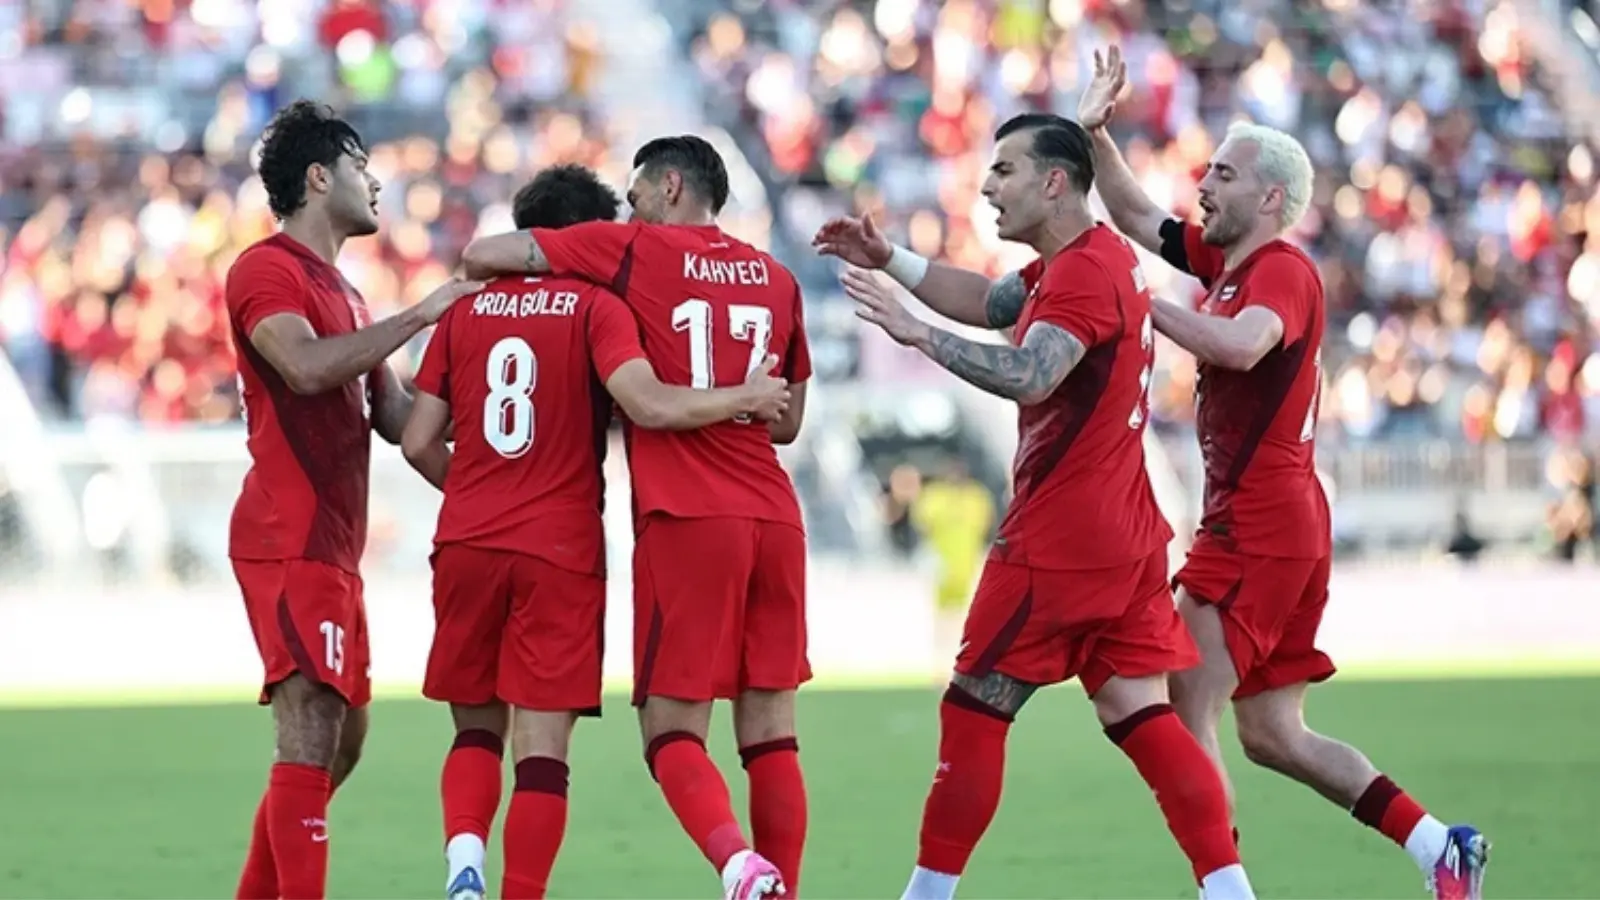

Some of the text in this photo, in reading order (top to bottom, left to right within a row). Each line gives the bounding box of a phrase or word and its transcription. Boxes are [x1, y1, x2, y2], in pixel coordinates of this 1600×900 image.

[469, 287, 579, 318] ARDA GÜLER
[483, 336, 537, 459] 8
[672, 298, 774, 424] 17
[319, 620, 345, 677] 15
